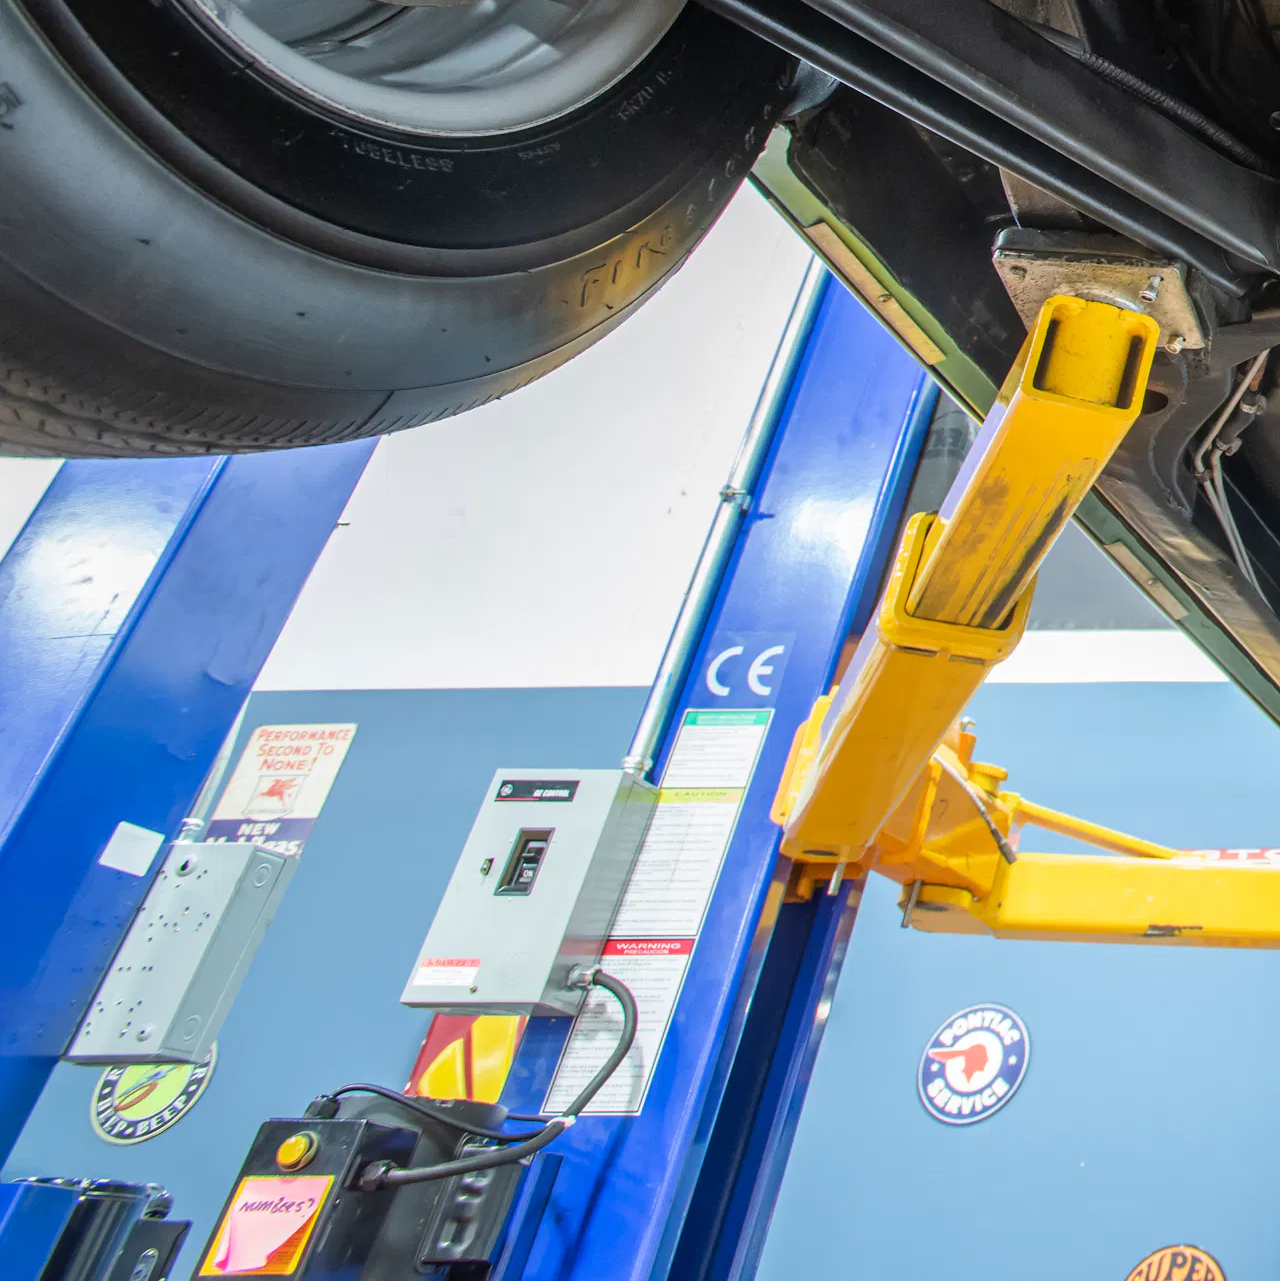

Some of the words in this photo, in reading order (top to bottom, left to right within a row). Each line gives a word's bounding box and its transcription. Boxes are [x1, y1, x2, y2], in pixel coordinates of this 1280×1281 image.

[257, 729, 351, 743] PERFORMANCE
[256, 743, 313, 757] SECOND
[259, 756, 318, 772] NONE!
[237, 822, 281, 836] NEW
[523, 869, 534, 878] ON
[939, 1010, 1021, 1046] PONTIAC
[927, 1077, 1010, 1115] SERVICE
[134, 1095, 188, 1137] BEEP
[1132, 1252, 1217, 1281] UPER
